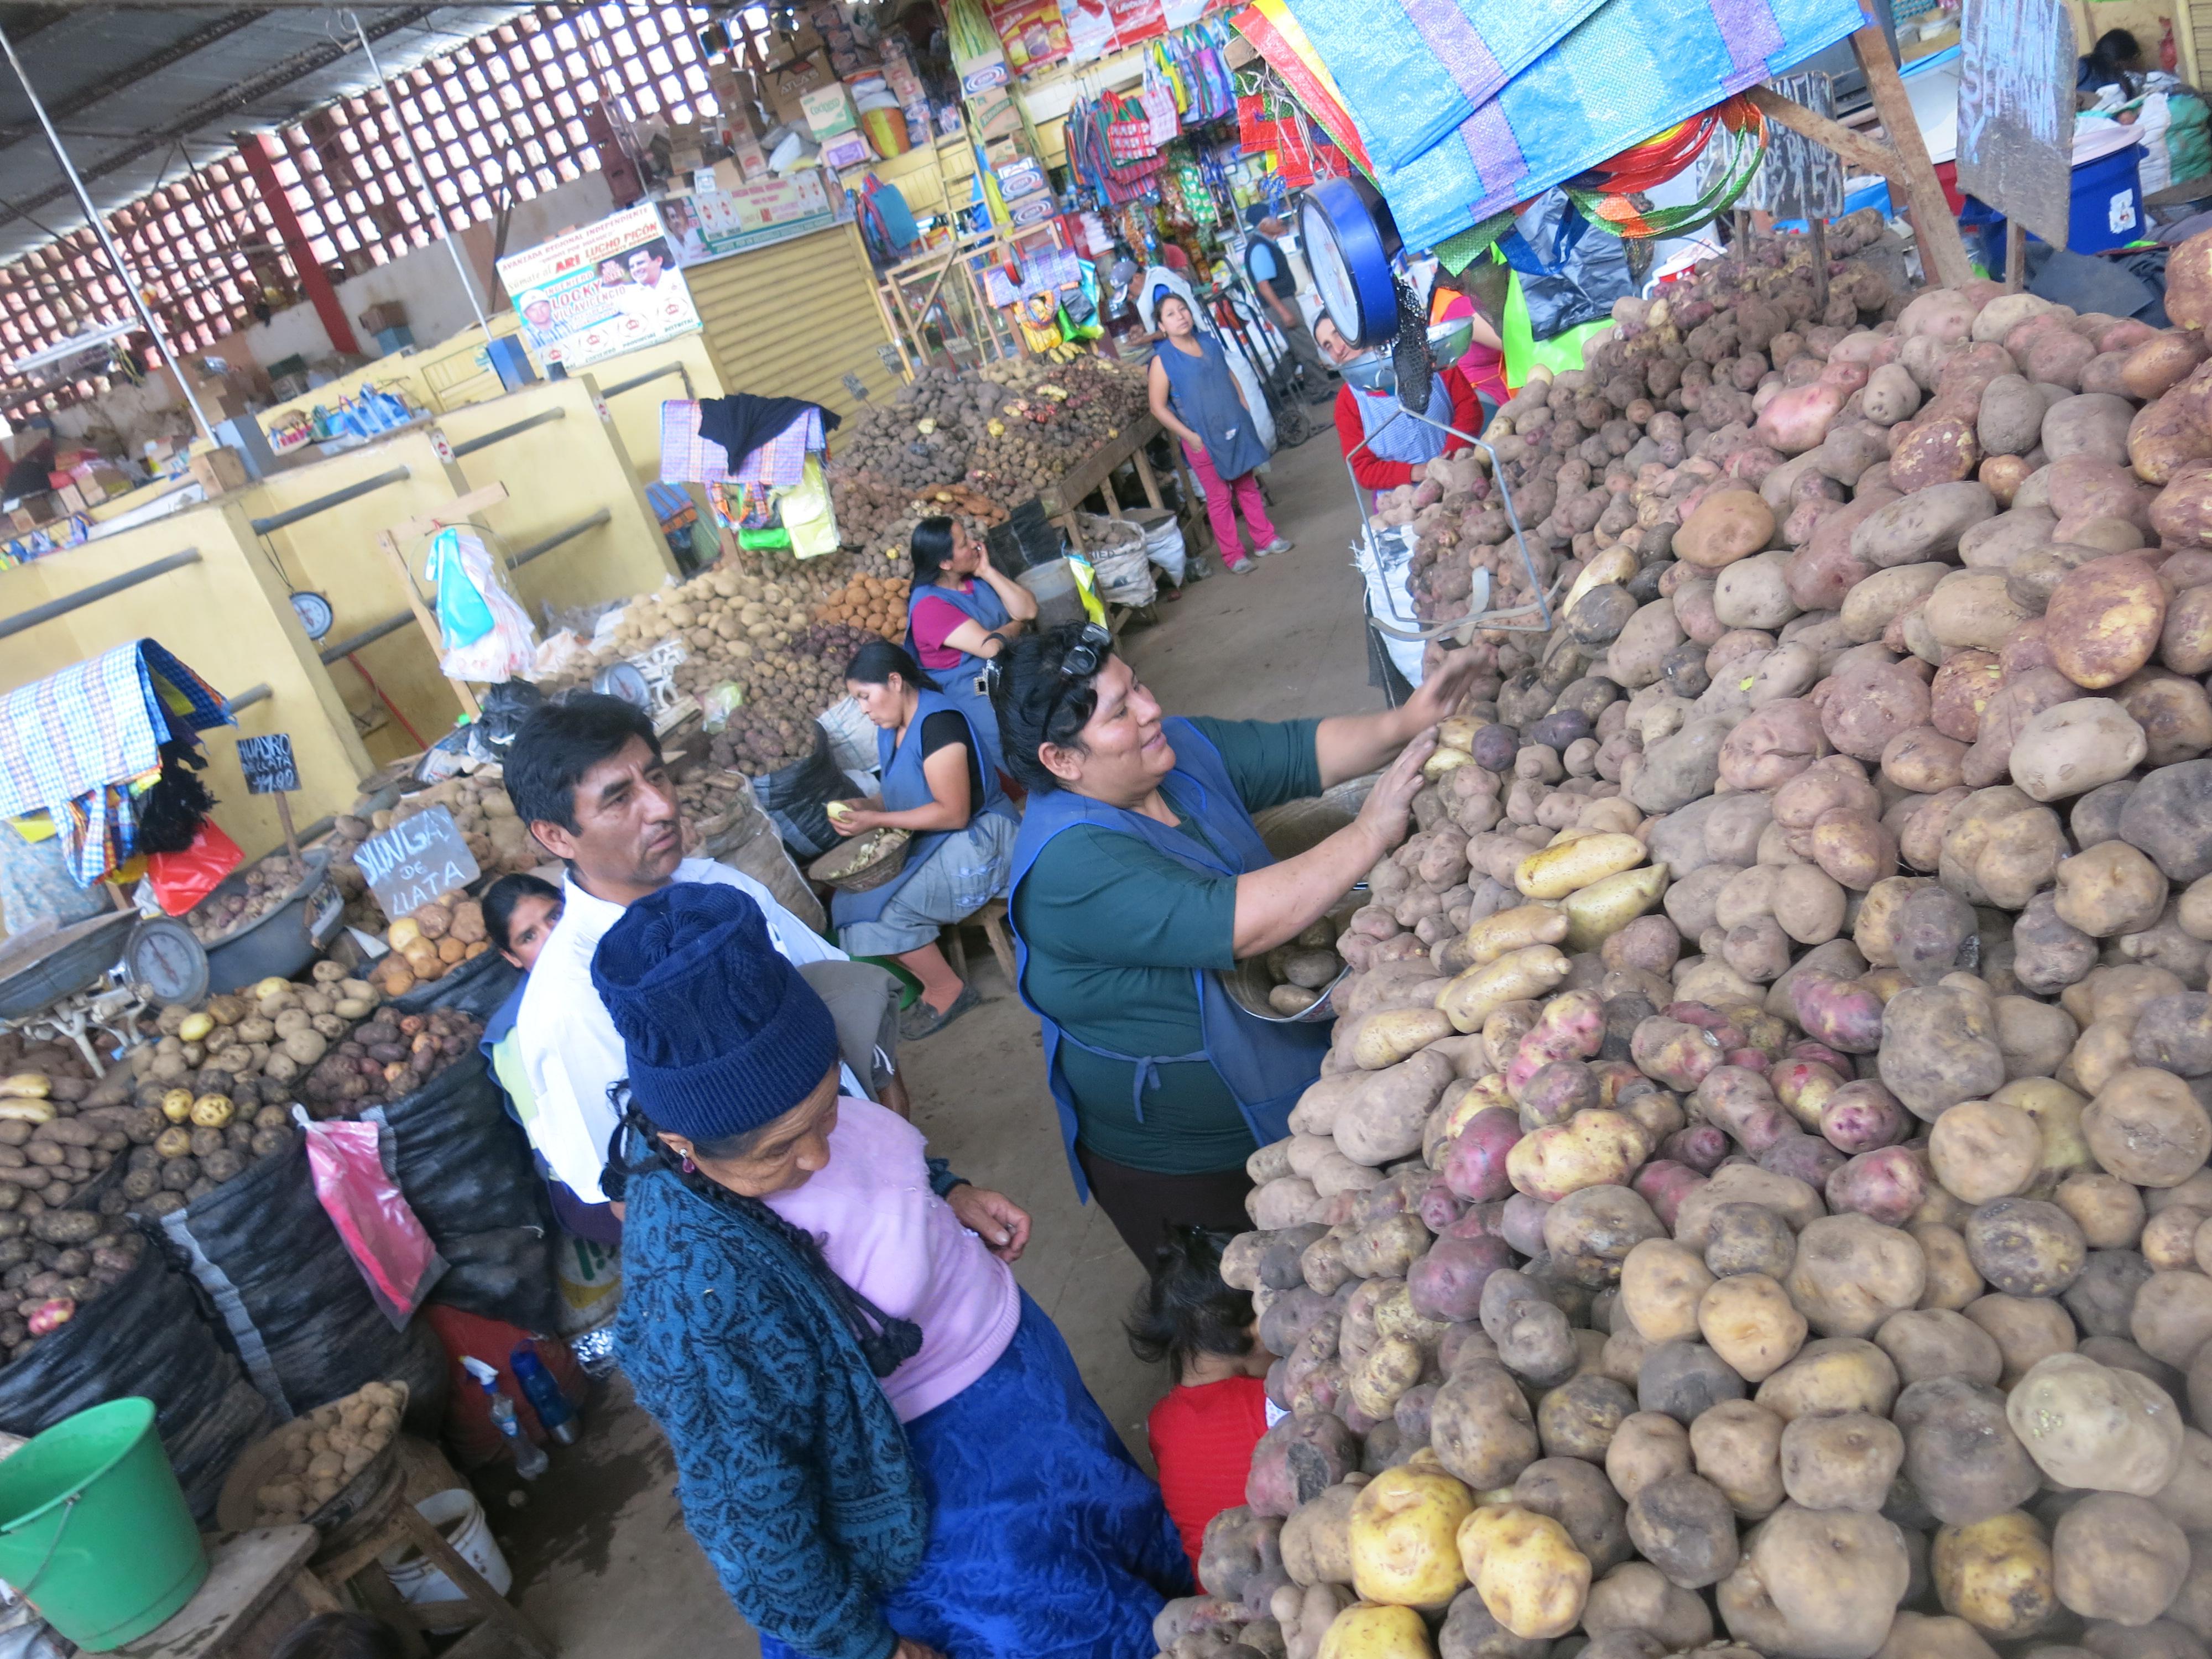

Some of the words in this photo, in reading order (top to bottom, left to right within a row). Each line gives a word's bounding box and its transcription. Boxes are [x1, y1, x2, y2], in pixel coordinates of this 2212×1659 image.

[780, 69, 820, 96] ATLAS
[502, 249, 544, 272] AVANZADA
[545, 233, 583, 253] REGIONAL
[586, 207, 649, 237] INDEPENDIENTE
[585, 237, 621, 258] LUCHO
[623, 221, 658, 242] PICÓN
[542, 264, 551, 276] al
[555, 254, 581, 274] ARI
[545, 271, 594, 298] INGENIERO
[551, 279, 601, 310] LOCKY
[554, 286, 626, 321] VILLAVICENCIO
[353, 810, 448, 886] YUNGA
[399, 860, 427, 880] DE
